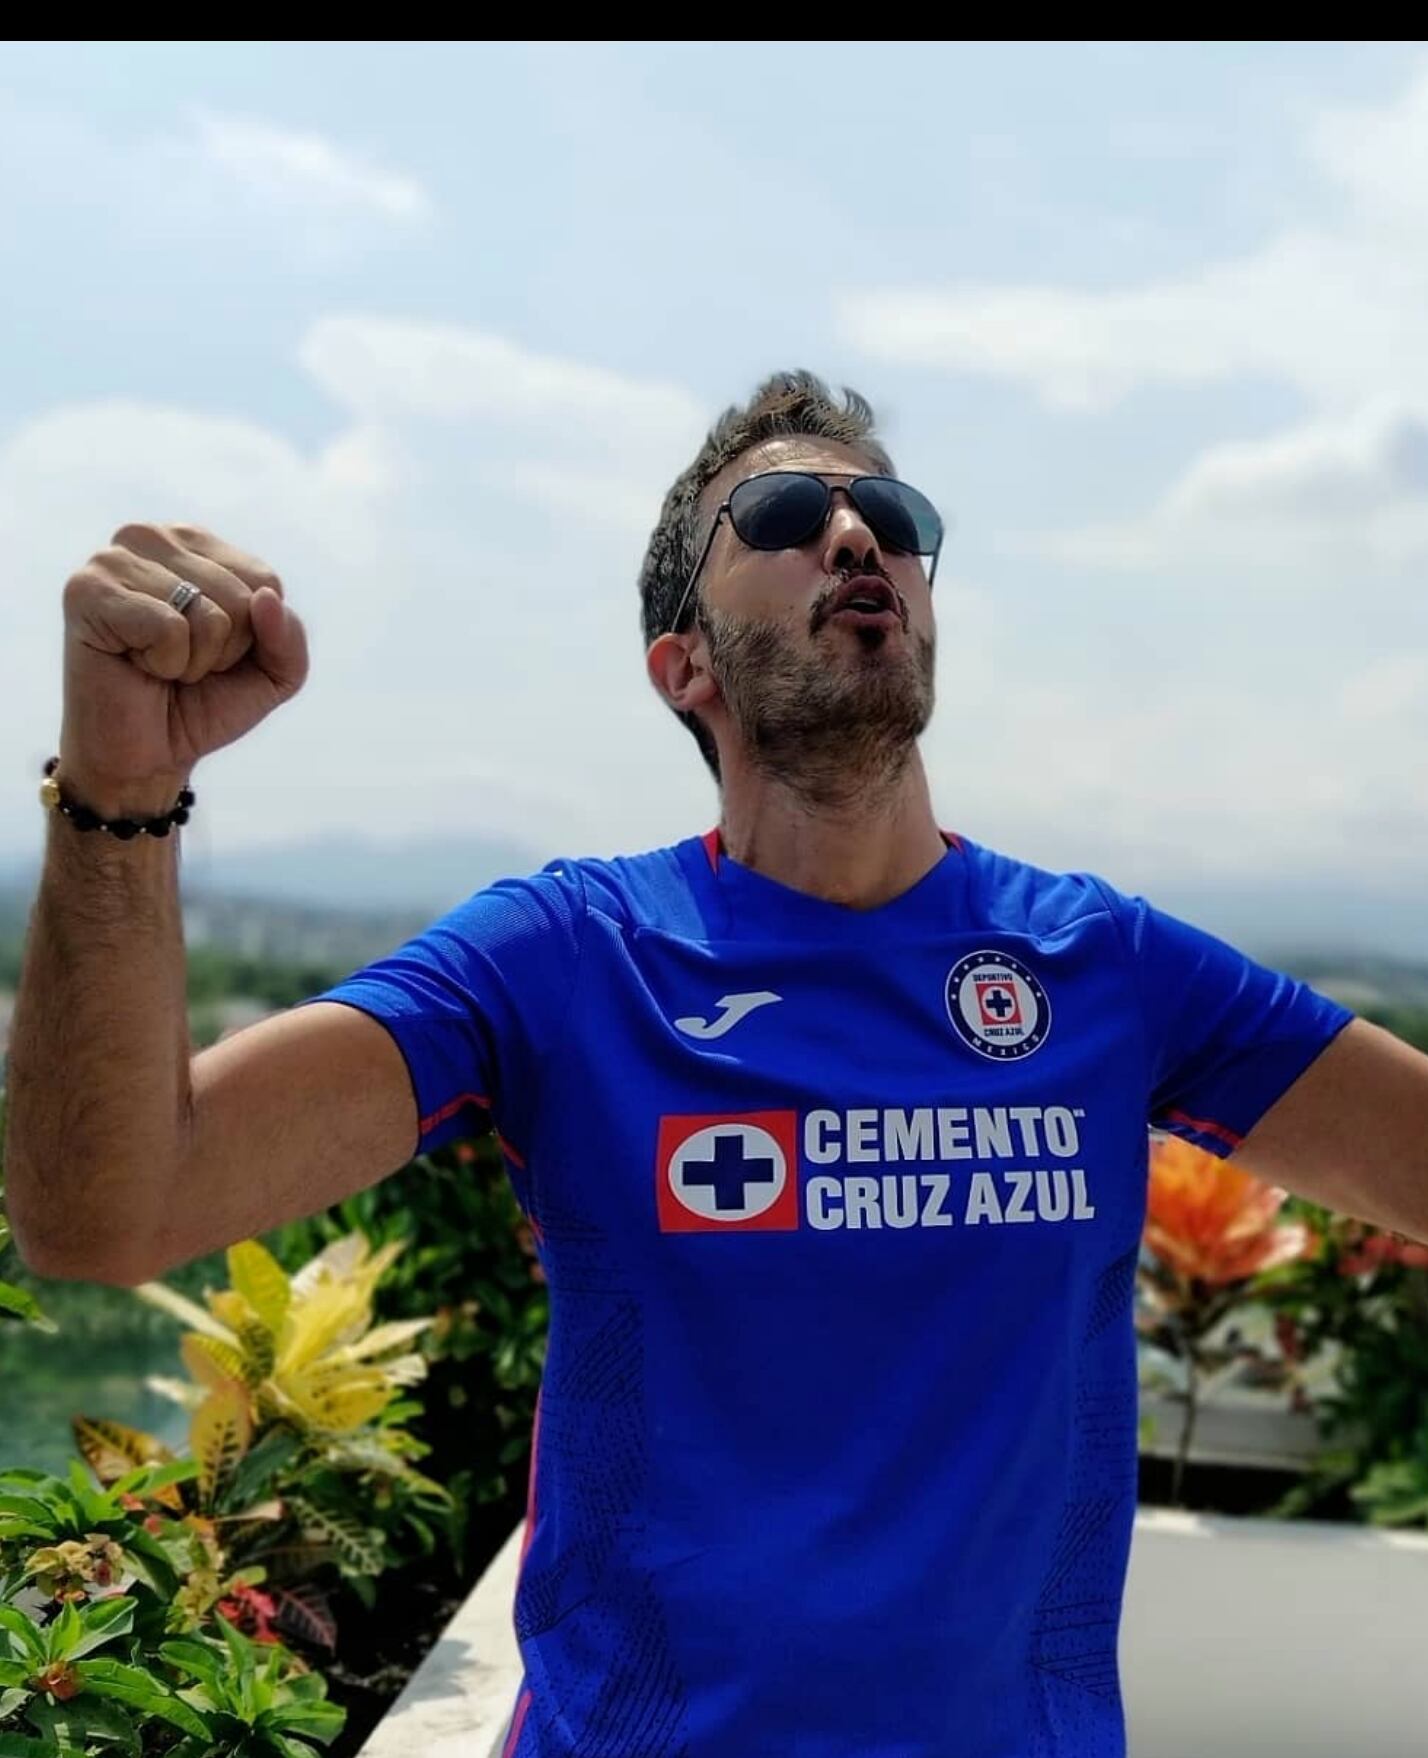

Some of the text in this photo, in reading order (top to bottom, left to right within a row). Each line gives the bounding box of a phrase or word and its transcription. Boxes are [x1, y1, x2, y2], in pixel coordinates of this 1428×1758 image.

[804, 1106, 1078, 1164] CEMENTO
[806, 1169, 1095, 1231] CRUZ AZUL
